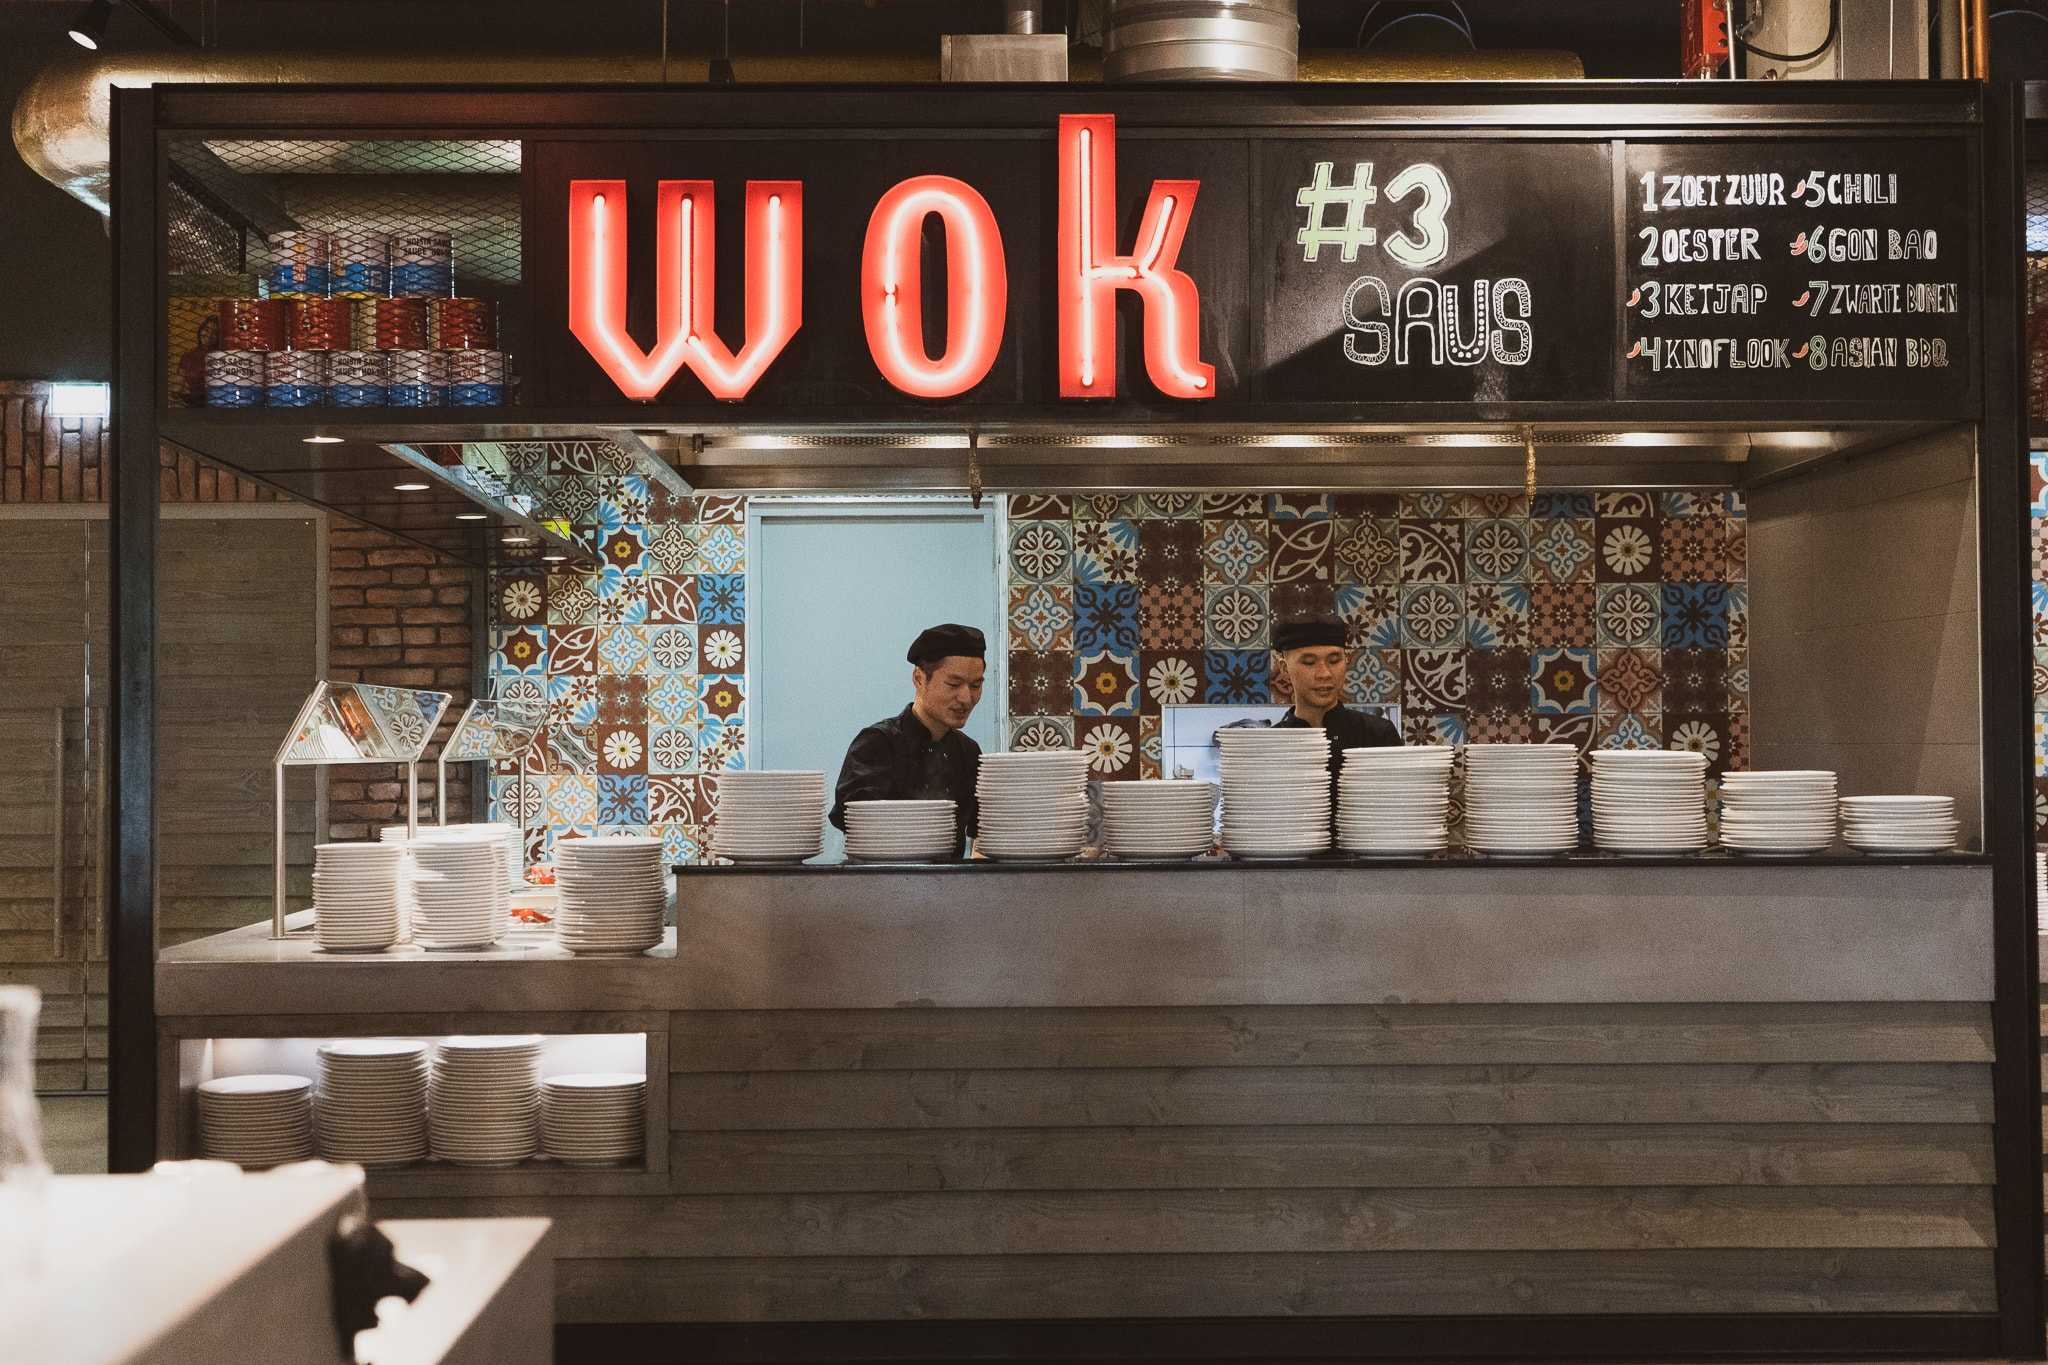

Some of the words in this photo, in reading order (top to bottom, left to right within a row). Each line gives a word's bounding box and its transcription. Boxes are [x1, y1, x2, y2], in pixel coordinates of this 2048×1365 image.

[1661, 175, 1721, 207] ZOET
[1725, 173, 1787, 206] ZUUR
[1827, 173, 1897, 205] CHILI
[1296, 162, 1451, 268] #3
[569, 113, 1215, 399] wok
[1662, 228, 1761, 263] OESTER
[1829, 228, 1877, 262] GON
[1888, 229, 1938, 260] BAO
[1665, 284, 1767, 315] KETJAP
[1829, 284, 1901, 314] ZWARTE
[1906, 283, 1957, 313] BONEN
[1343, 276, 1532, 366] SAUS
[1665, 338, 1791, 369] KNOFLOOK
[1831, 337, 1897, 368] ASIAN
[1905, 338, 1949, 367] BBQ
